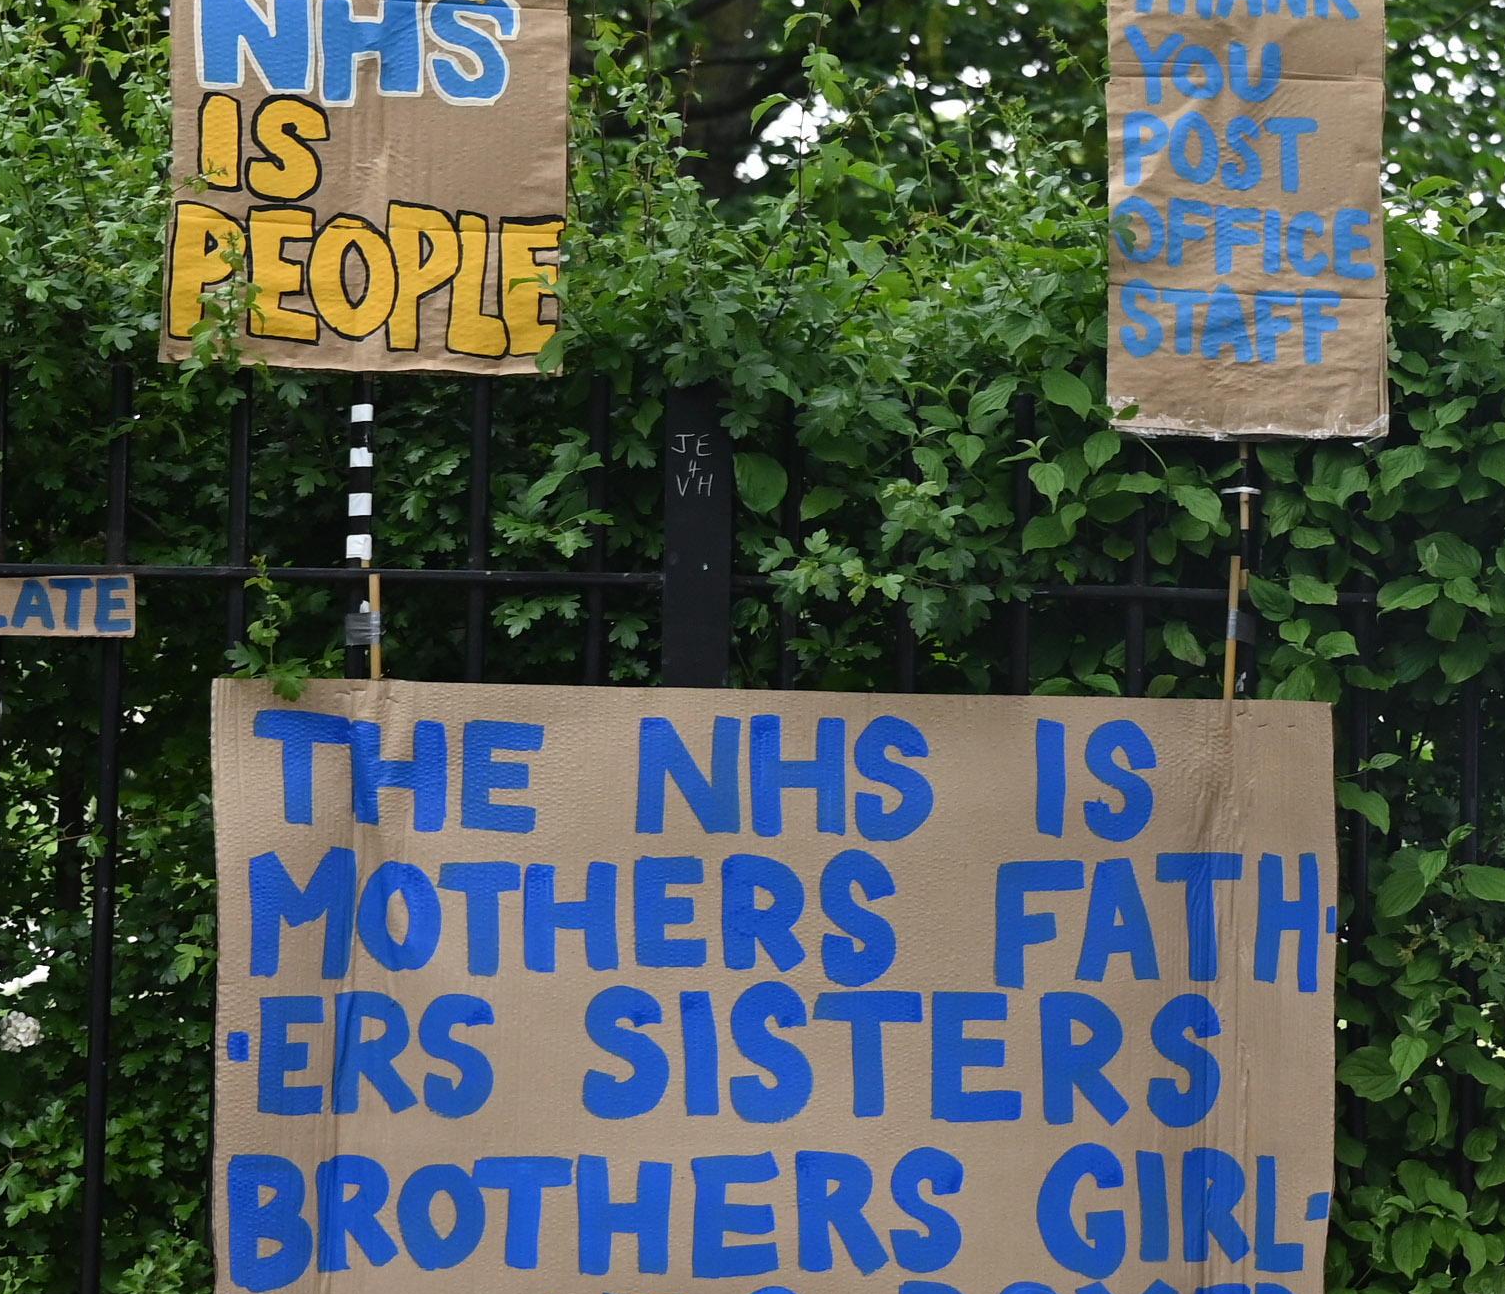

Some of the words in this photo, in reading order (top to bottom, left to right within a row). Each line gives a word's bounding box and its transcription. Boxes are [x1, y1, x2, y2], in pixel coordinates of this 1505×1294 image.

[1124, 25, 1281, 104] YOU
[197, 93, 330, 202] IS
[1123, 111, 1318, 192] POST
[1119, 279, 1341, 364] STAFF
[253, 710, 545, 833] THE
[635, 713, 934, 842] NHS
[1034, 719, 1157, 842] IS
[248, 846, 897, 986] MOTHERS
[582, 981, 1223, 1128] SISTERS
[227, 1147, 964, 1292] BROTHERS
